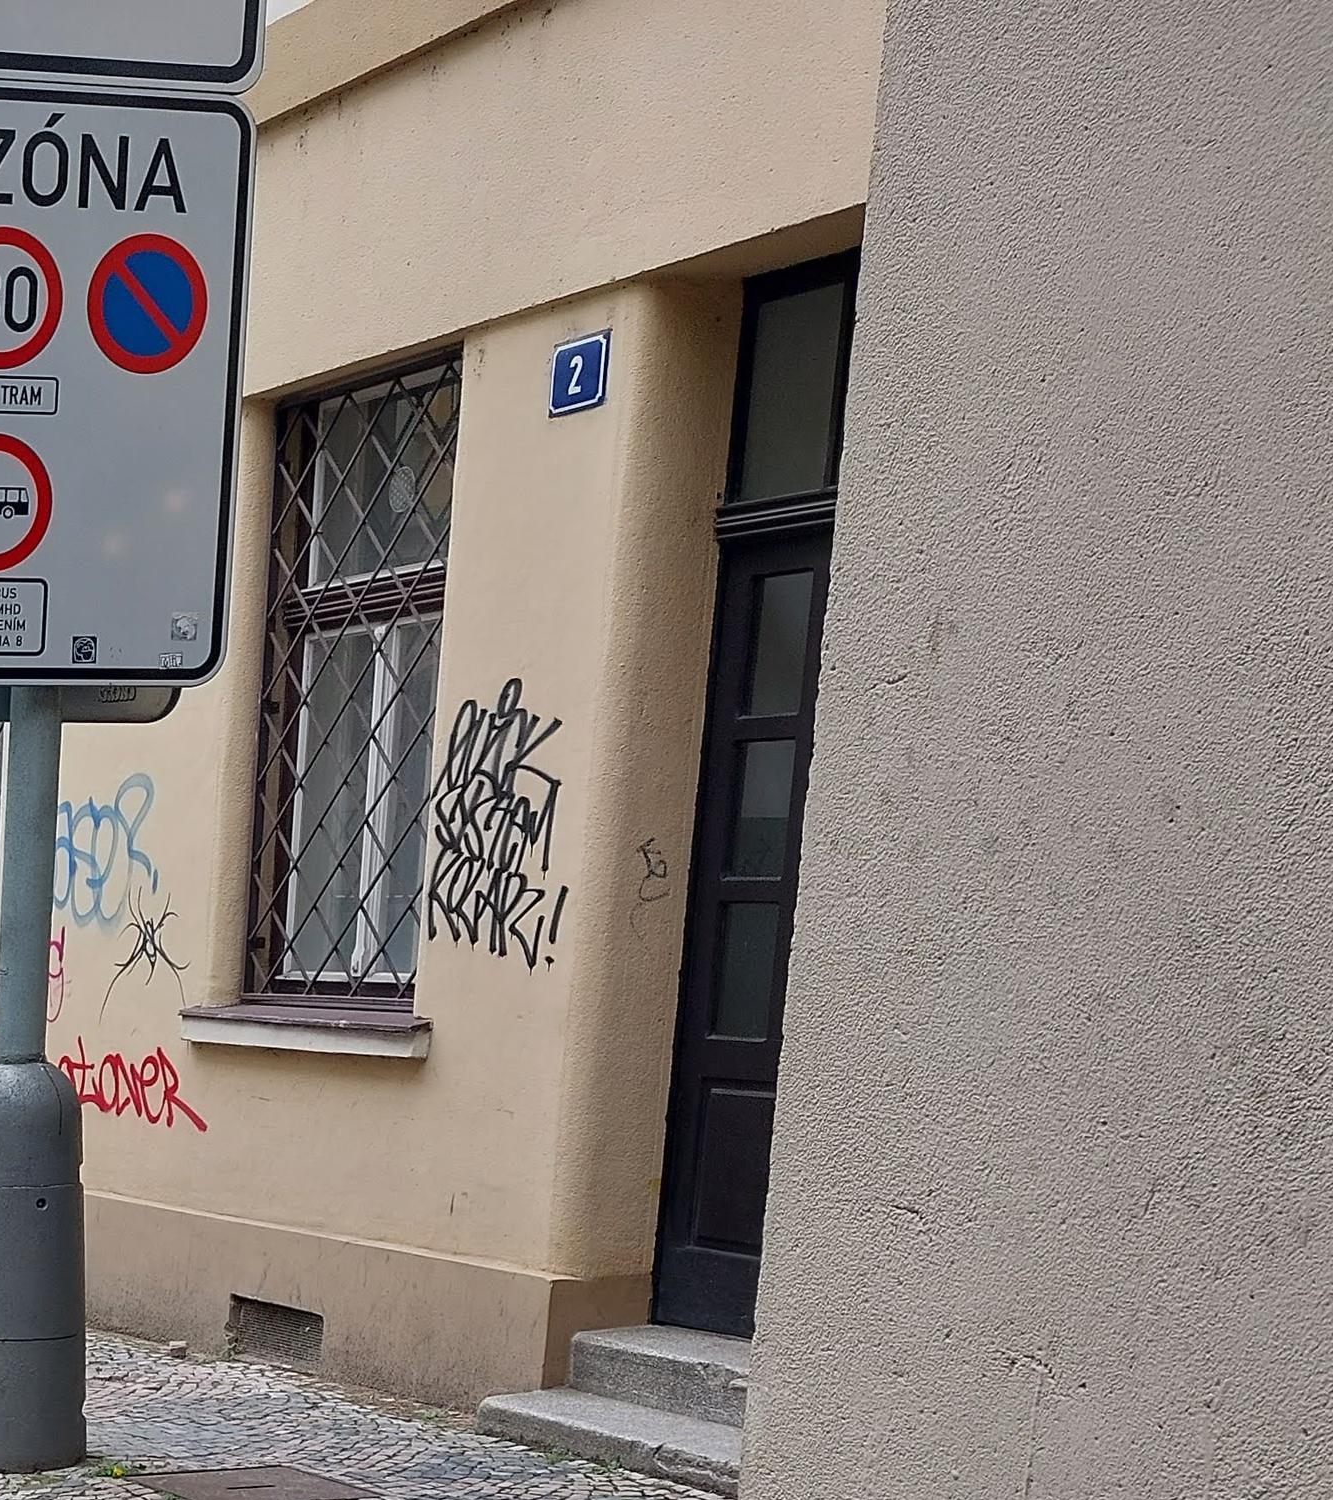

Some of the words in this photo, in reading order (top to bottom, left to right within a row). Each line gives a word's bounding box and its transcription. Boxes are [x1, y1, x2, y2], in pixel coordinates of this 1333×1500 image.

[568, 355, 583, 396] 2
[1, 385, 42, 406] TRAM
[16, 635, 23, 647] 8
